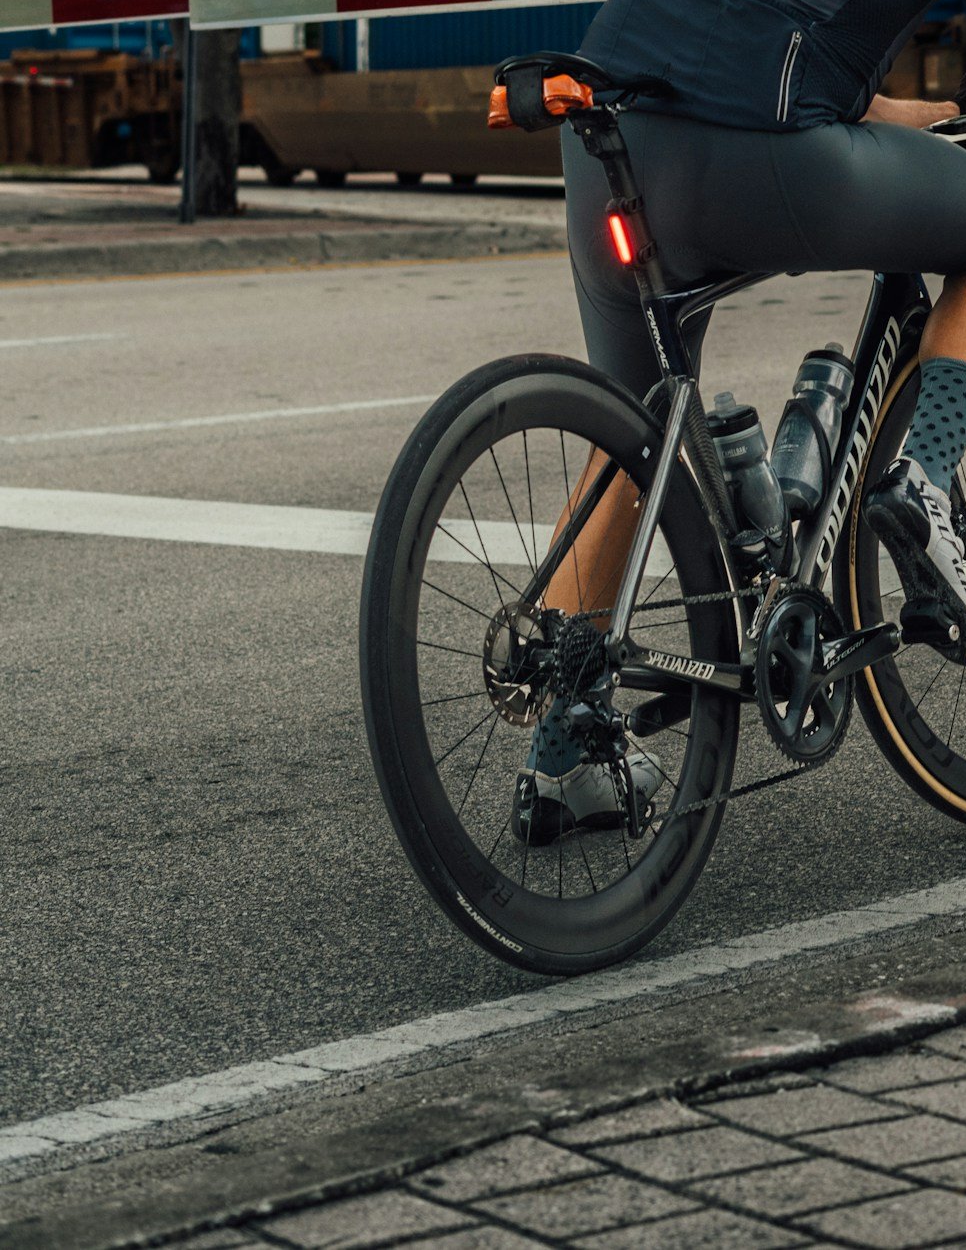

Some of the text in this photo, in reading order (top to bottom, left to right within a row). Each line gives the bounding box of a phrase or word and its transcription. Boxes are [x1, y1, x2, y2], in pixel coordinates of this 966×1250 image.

[646, 306, 670, 370] TARMAC
[644, 650, 716, 680] SPECIALIZED
[456, 890, 523, 953] CONTINENTAL
